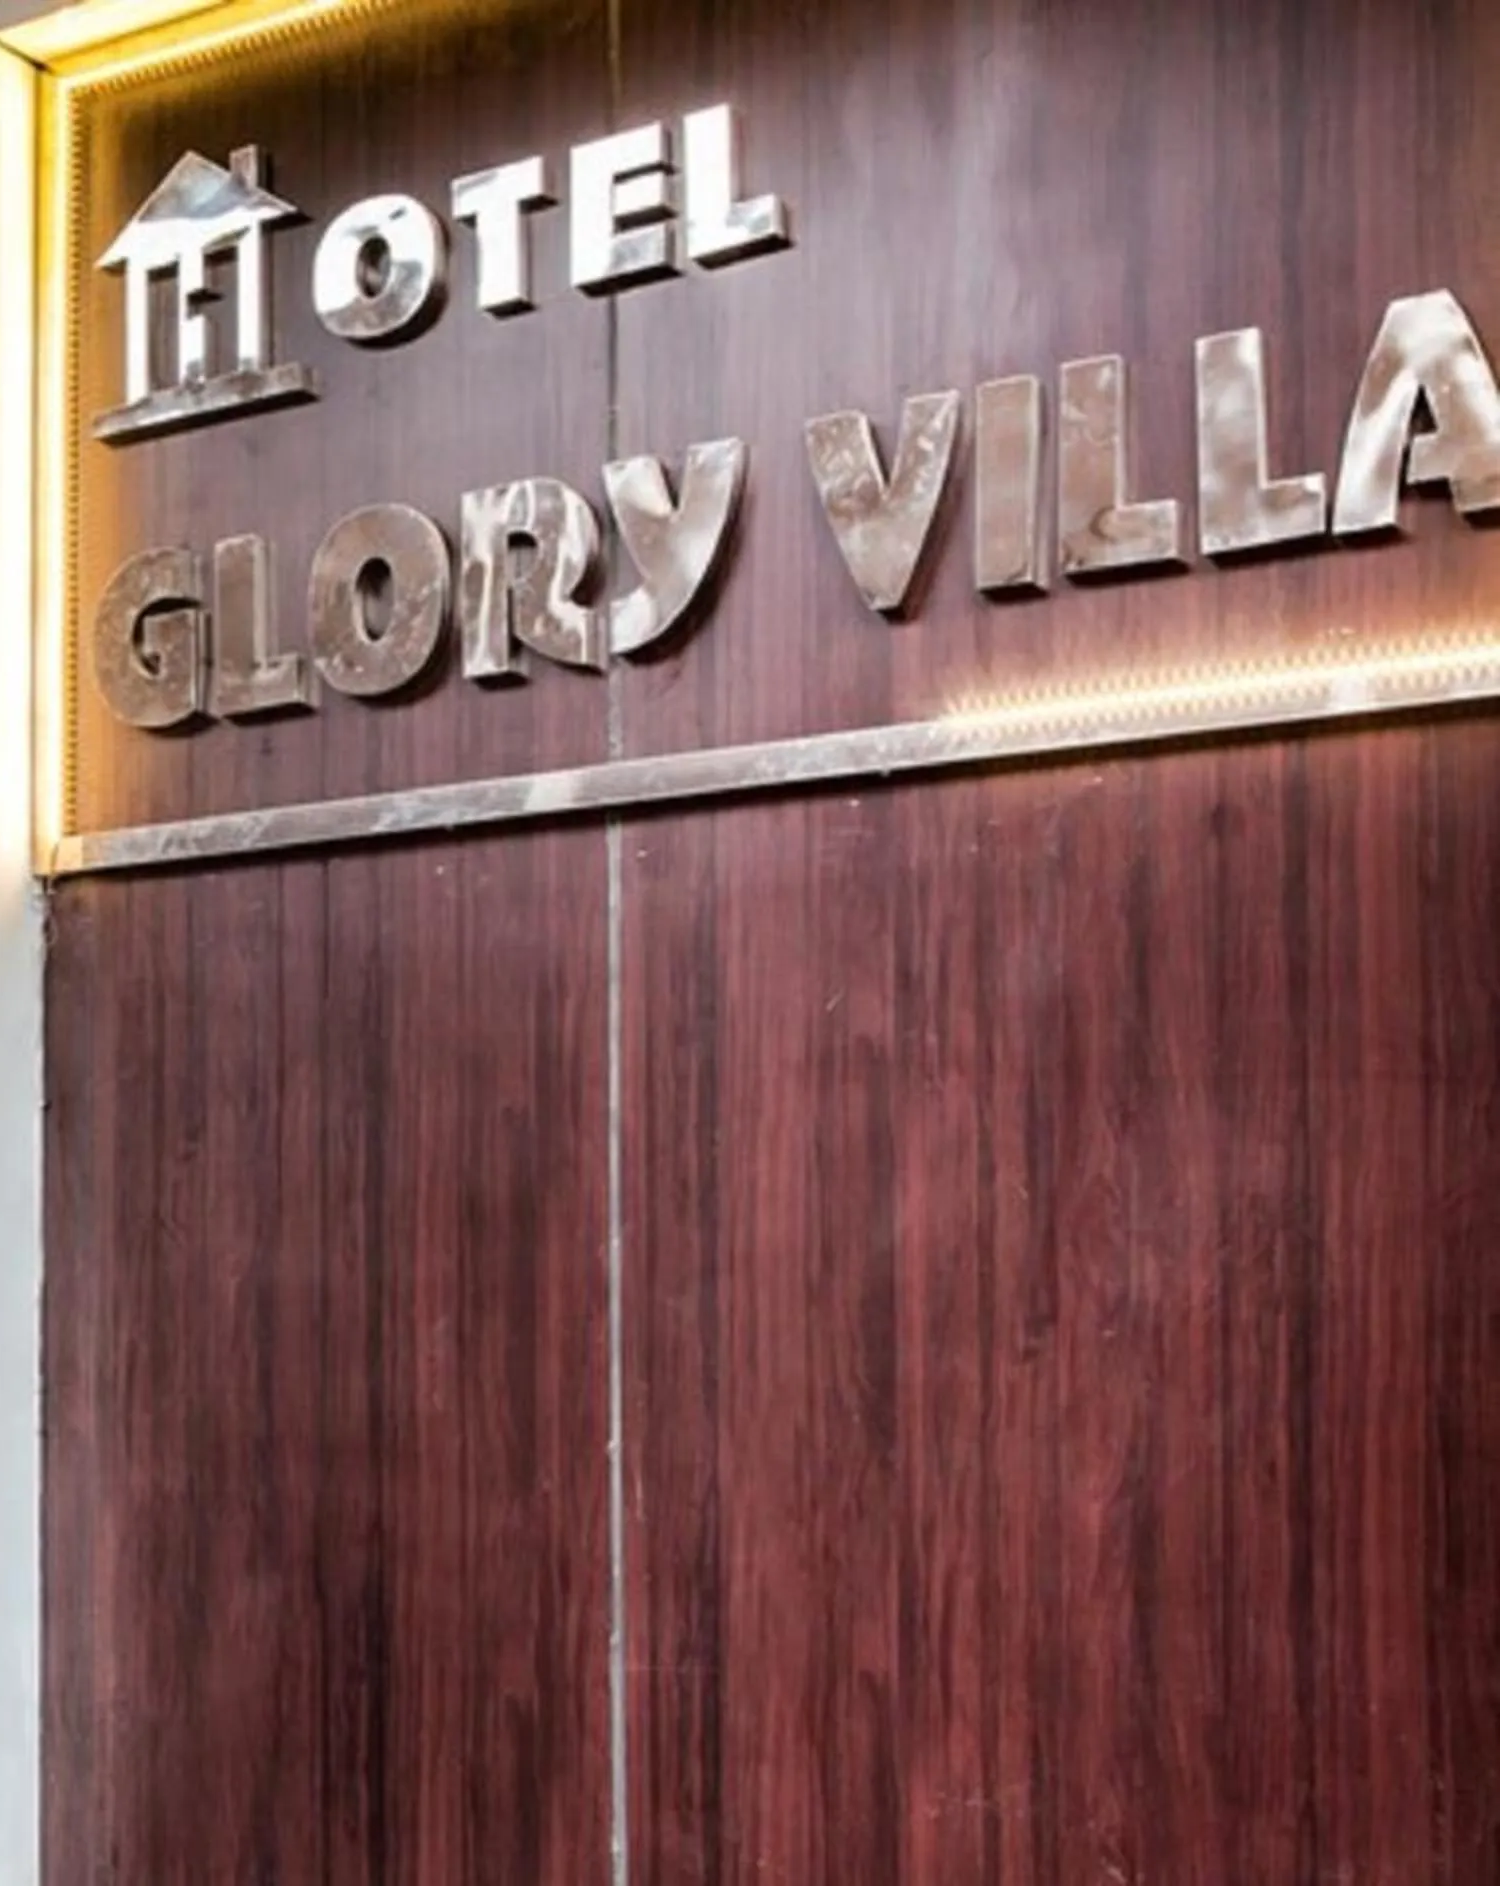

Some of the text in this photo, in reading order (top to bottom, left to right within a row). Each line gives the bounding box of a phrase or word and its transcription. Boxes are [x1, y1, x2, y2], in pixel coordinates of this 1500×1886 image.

[94, 103, 788, 442] HOTEL
[96, 288, 1500, 730] GLORY VILLA
